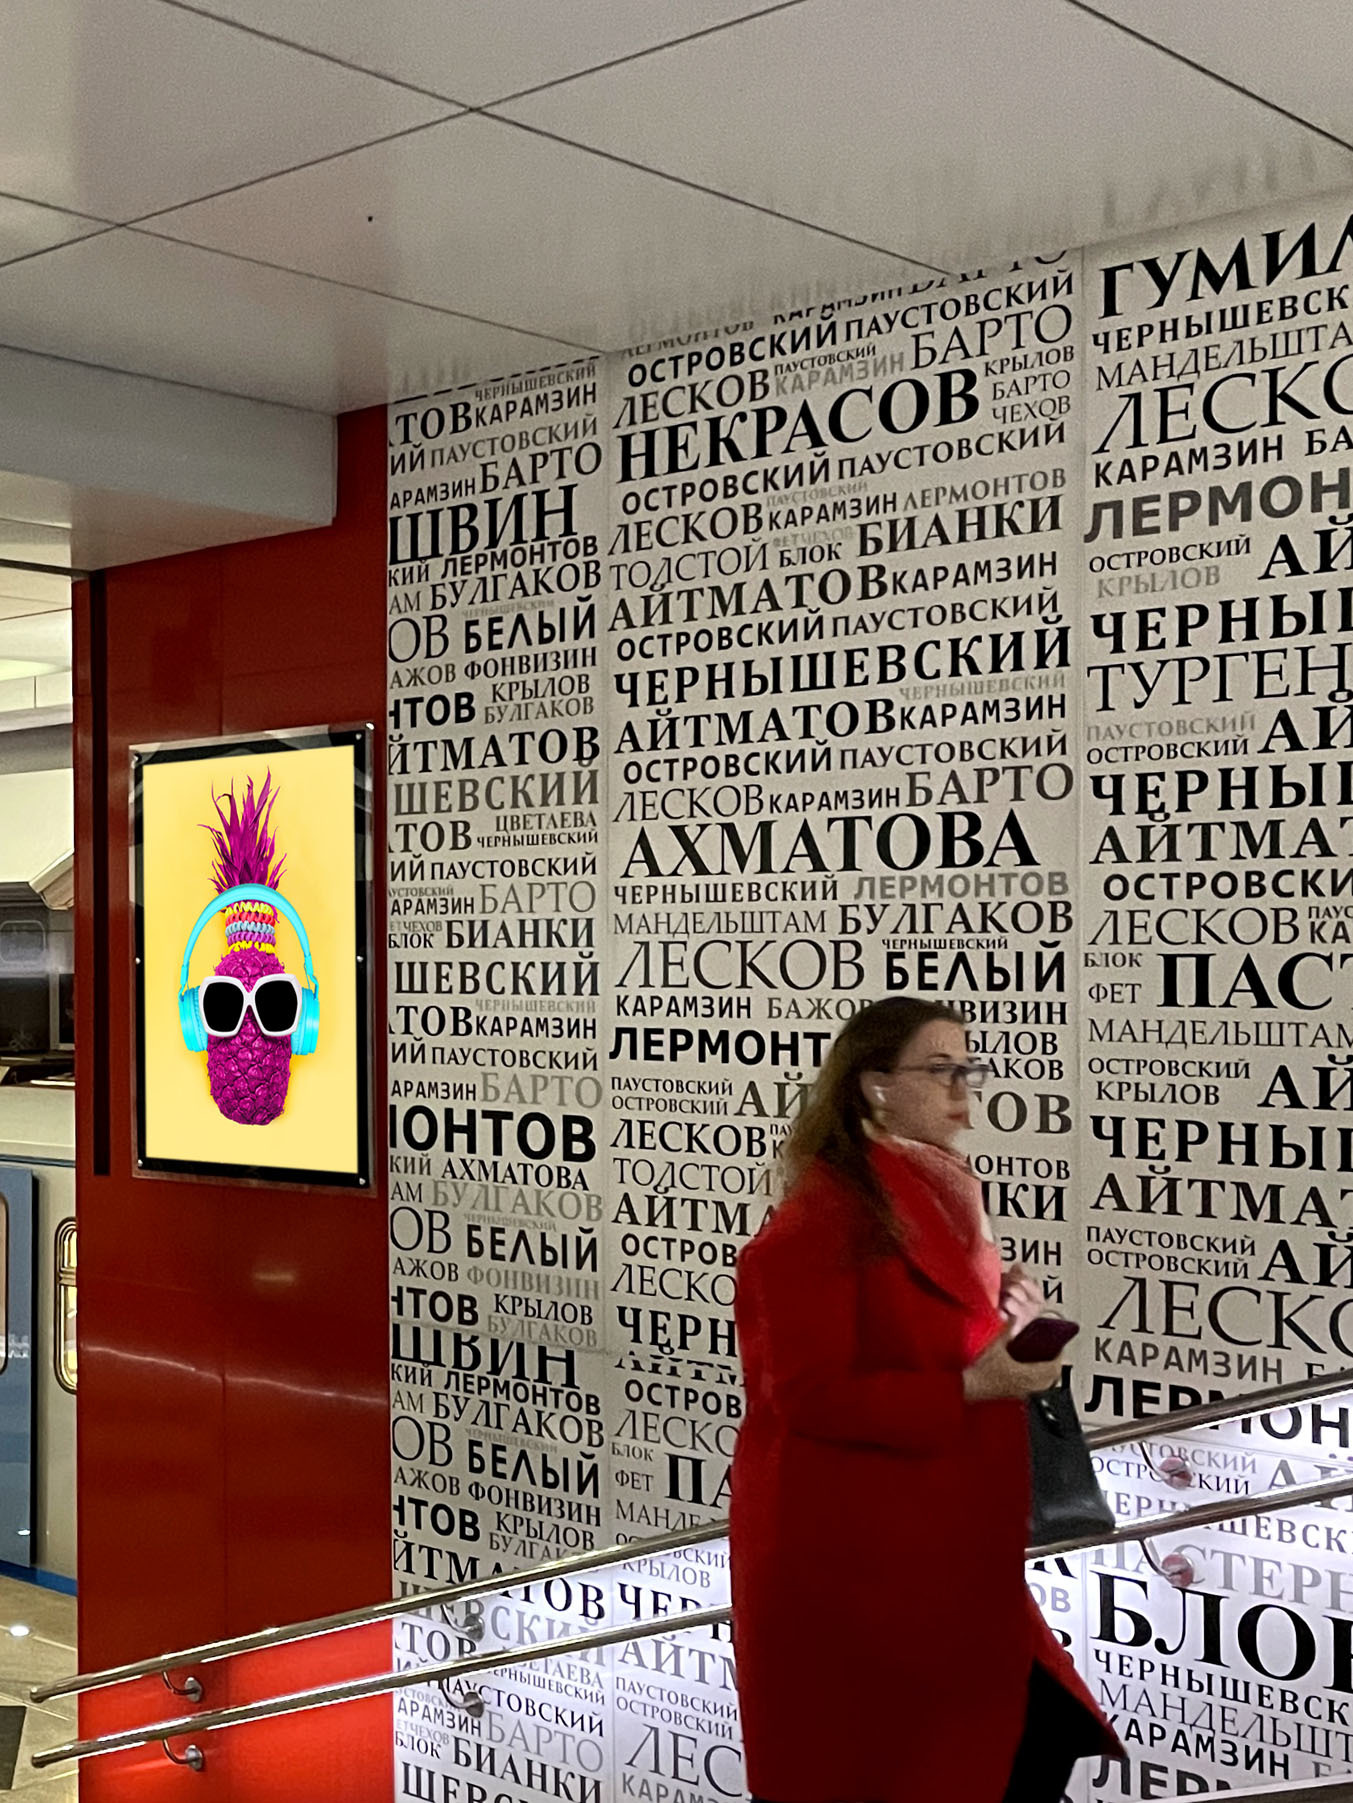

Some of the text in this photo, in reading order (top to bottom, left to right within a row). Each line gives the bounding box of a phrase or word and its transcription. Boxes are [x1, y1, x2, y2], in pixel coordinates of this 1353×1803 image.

[628, 312, 836, 387] ОСТРОВСКИЙ
[845, 268, 1073, 342] ПАУСТОВСКИЙ
[1091, 284, 1349, 355] ЧЕРНЫШЕВСК
[611, 368, 770, 430] ЛЕСКОВ
[775, 351, 904, 397] КАРАМЗИН
[910, 303, 1072, 370] БАРТО
[774, 342, 876, 377] ПАУСТОВСКИЙ
[984, 345, 1074, 377] КРЫЛОВ
[474, 362, 596, 402] ЧЕРНЫШЕВСКИЙ
[992, 369, 1070, 401] БАРТО
[475, 381, 596, 428] КАРАМЗИН
[991, 394, 1071, 425] ЧЕХОВ
[430, 412, 597, 468] ПАУСТОВСКИЙ
[616, 368, 979, 484] НЕКРАСОВ
[389, 441, 602, 511] АРАМЗИН БАРТО
[621, 416, 1064, 515] ОСТРОВСКИЙ ПАУСТОВСКИЙ
[1095, 434, 1282, 488] КАРАМЗИН
[607, 502, 763, 556] ЛЕСКОВ
[769, 492, 896, 531] КАРАМЗИН
[903, 467, 1066, 512] ЛЕРМОНТОВ
[1083, 466, 1350, 544] ЛЕРМОН
[440, 535, 598, 579] ЛЕРМОНТОВ
[609, 537, 768, 591] ТОЛСТОЙ
[779, 542, 842, 568] БЛОК
[857, 494, 1062, 557] БИАНКИ
[1089, 533, 1250, 573] ОСТРОВСКИЙ
[429, 559, 601, 611] БУЛГАКОВ
[607, 550, 1056, 632] АЙТМАТОВ КАРАМЗИН
[1097, 564, 1220, 599] КРЫЛОВ
[465, 594, 595, 654] БЕЛЫЙ
[617, 607, 824, 662] ОСТРОВСКИЙ
[832, 586, 1058, 638] ПАУСТОВСКИЙ
[464, 646, 596, 680] ФОНВИЗИН
[613, 614, 1071, 708] ЧЕРНЫШЕВСКИЙ
[1087, 642, 1353, 712] ТУРГЕН
[491, 673, 590, 703] КРЫЛОВ
[484, 695, 594, 725] БУЛГАКОВ
[613, 693, 1066, 754] АЙТМАТОВ КАРАМЗИН
[1086, 710, 1256, 742] ПАУСТОВСКИЙ
[623, 728, 1067, 784] ОСТРОВСКИЙ ПАУСТОВСКИЙ
[1086, 734, 1248, 764] ОСТРОВСКИЙ
[393, 756, 599, 816] ШЕВСКИЙ
[612, 762, 1074, 823] ЛЕСКОВ КАРАМЗИН БАРТО
[476, 828, 598, 848] ЧЕРНЫШЕВСКИЙ
[495, 810, 597, 834] ЦВЕТАЕВА
[619, 807, 1041, 879] АХМАТОВА
[430, 851, 596, 880] ПАУСТОВСКИЙ
[390, 880, 596, 916] АРАМЗИН БАРТО
[613, 870, 1069, 905] ЧЕРНЫШЕВСКИЙ ЛЕРМОНТОВ
[445, 917, 594, 948] БИАНКИ
[613, 900, 1073, 938] МАНДЕЛЬШТАМ БУЛГАКОВ
[1087, 907, 1300, 945] ЛЕСКОВ
[881, 936, 1008, 950] ЧЕРНЫШЕВСКИЙ
[1084, 952, 1143, 968] БЛОК
[394, 950, 600, 996] ШЕВСКИЙ
[614, 939, 864, 990] ЛЕСКОВ
[886, 939, 1064, 992] БЕЛЫЙ
[616, 994, 751, 1019] КАРАМЗИН
[1088, 982, 1142, 1004] ФЕТ
[476, 1015, 596, 1039] КАРАМЗИН
[431, 1046, 598, 1071] ПАУСТОВСКИЙ
[1088, 1057, 1250, 1079] ОСТРОВСКИЙ
[390, 1071, 603, 1109] АРАМЗИН БАРТО
[611, 1076, 732, 1096] ПАУСТОВСКИЙ
[611, 1095, 728, 1116] ОСТРОВСКИЙ
[1096, 1080, 1220, 1105] КРЫЛОВ
[609, 1118, 766, 1158] ЛЕСКОВ
[441, 1157, 589, 1191] АХМАТОВА
[613, 1157, 772, 1197] ТОЛСТОЙ
[431, 1178, 603, 1222] БУЛГАКОВ
[467, 1223, 597, 1272] БЕЛЫЙ
[1086, 1225, 1256, 1256] ПАУСТОВСКИЙ
[466, 1265, 599, 1301] ФОНВИЗИН
[1087, 1248, 1249, 1279] ОСТРОВСКИЙ
[494, 1293, 593, 1326] КРЫЛОВ
[487, 1313, 598, 1350] БУЛГАКОВ
[1095, 1336, 1284, 1388] КАРАМЗИН
[443, 1369, 600, 1416] ЛЕРМОНТОВ
[432, 1391, 604, 1448] БУЛГАКОВ
[468, 1438, 599, 1499] БЕЛЫЙ
[611, 1441, 654, 1462] БЛОК
[615, 1469, 654, 1492] ФЕТ
[468, 1481, 600, 1527] ФОНВИЗИН
[495, 1510, 594, 1551] КРЫЛОВ
[616, 1676, 738, 1722] ПАУСТОВСКИЙ
[1094, 1648, 1349, 1727] ЧЕРНЫШЕВСК
[397, 1697, 604, 1773] АРАМЗИН БАРТО
[616, 1696, 733, 1741] ОСТРОВСКИЙ
[395, 1730, 602, 1803] БЛОК БИАНКИ
